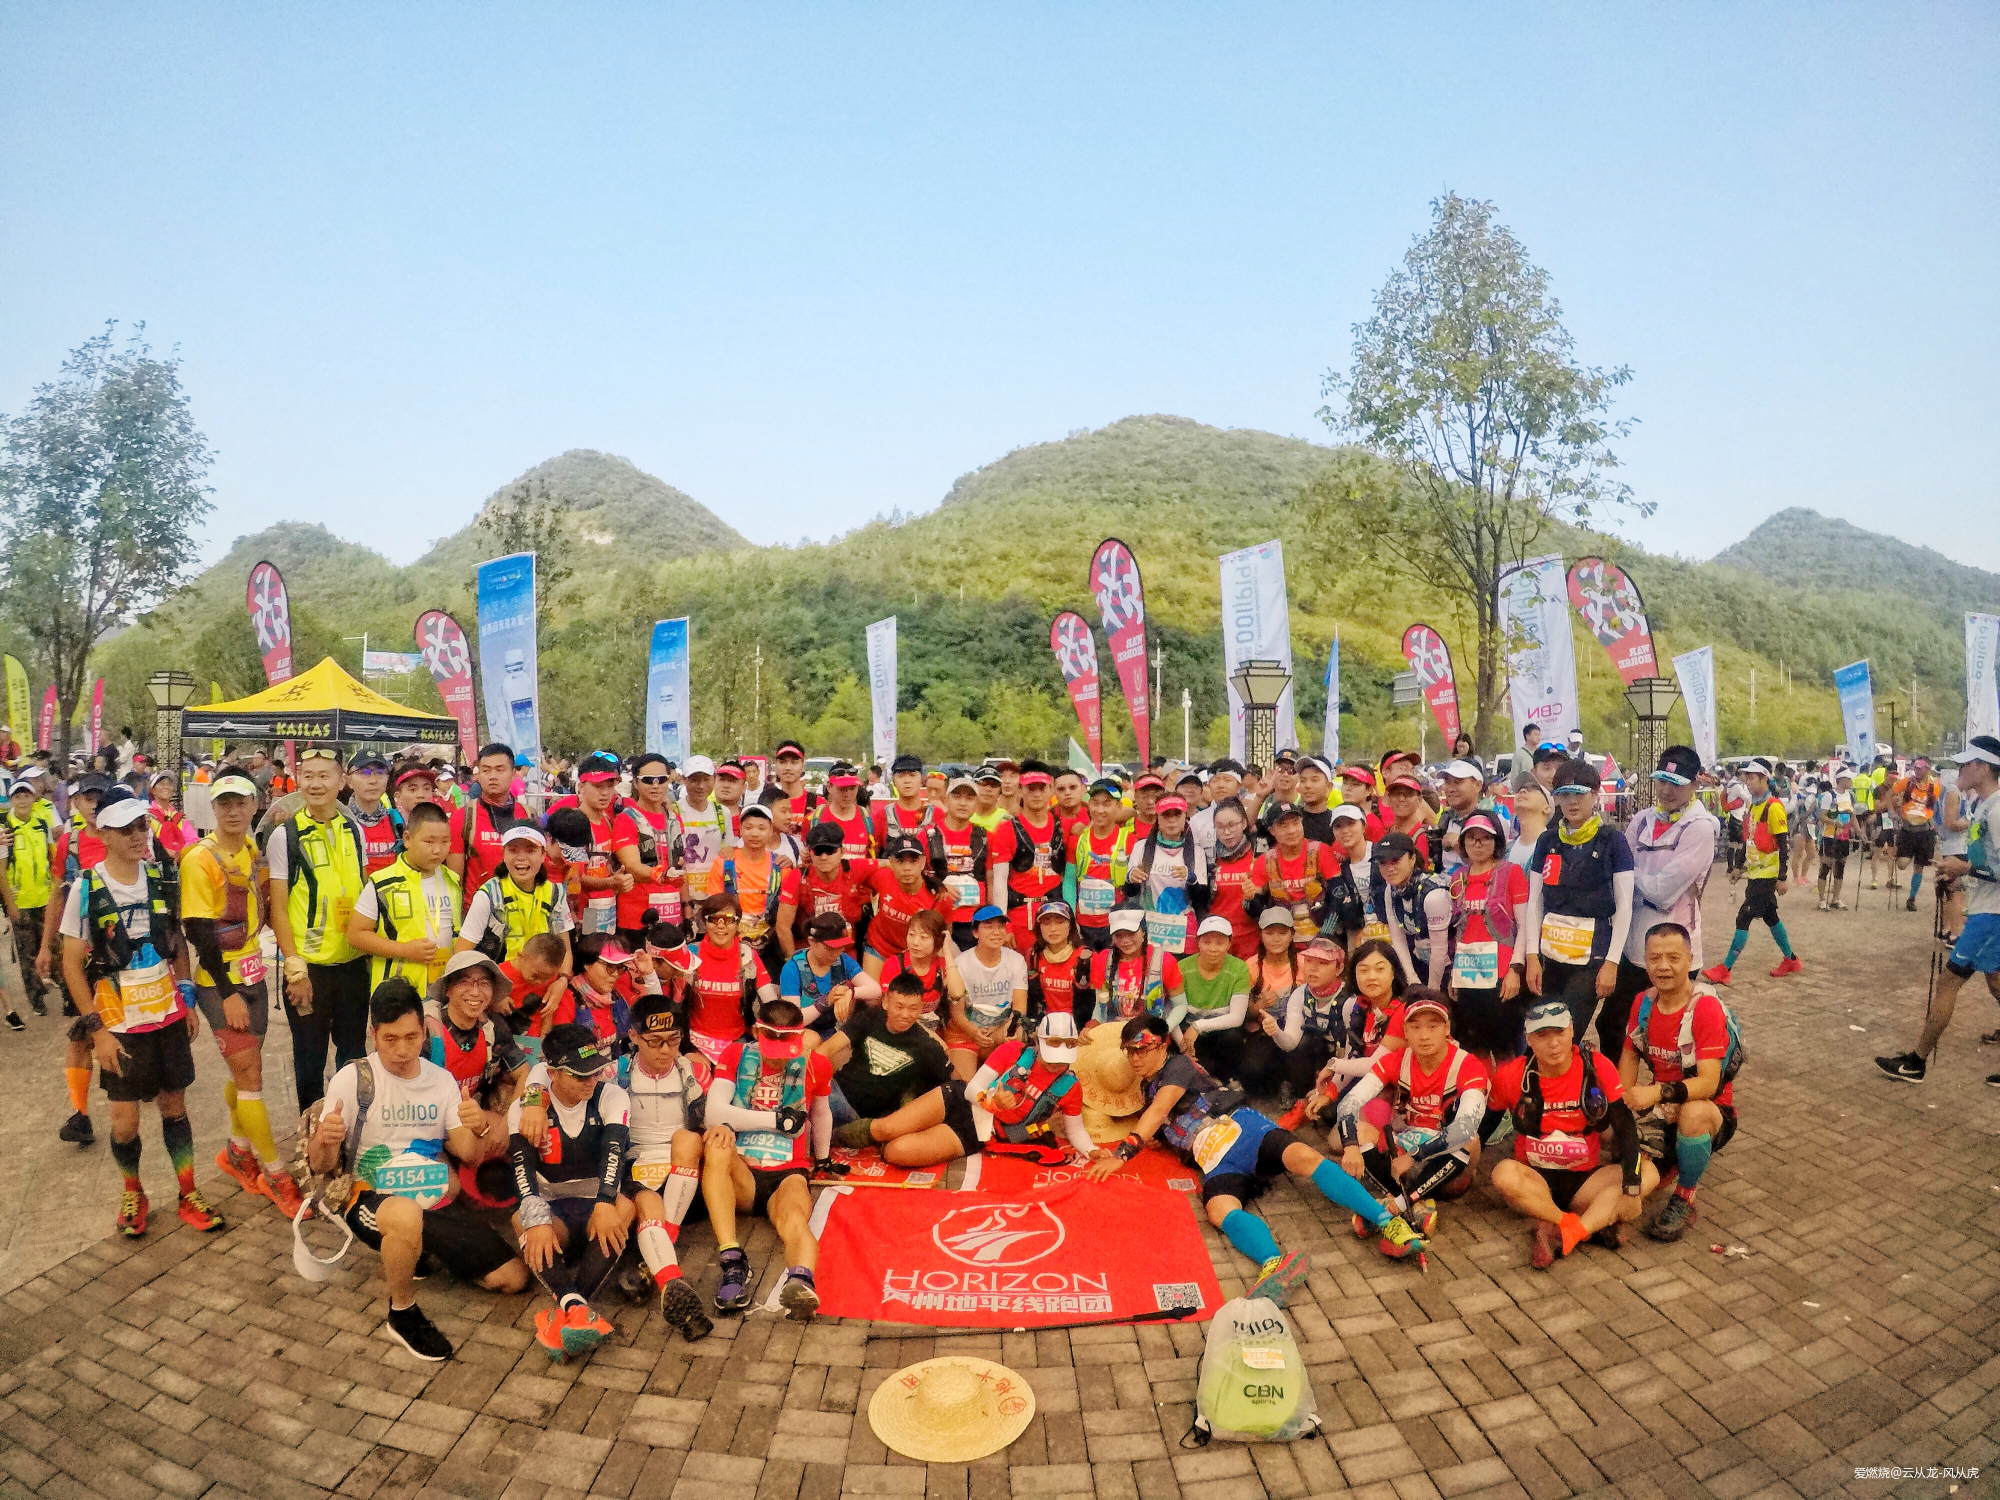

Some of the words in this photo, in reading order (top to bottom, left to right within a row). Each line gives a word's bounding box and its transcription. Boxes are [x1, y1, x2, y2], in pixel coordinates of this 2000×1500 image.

[276, 721, 331, 738] KAILAS
[420, 729, 456, 741] KAILAS
[1546, 927, 1575, 942] 4055
[130, 984, 164, 1002] 3066
[649, 1013, 673, 1029] Buff
[742, 1133, 775, 1148] 5092
[1530, 1141, 1564, 1156] 1009
[604, 1152, 619, 1186] JOYRUN
[385, 1168, 426, 1187] 5154
[883, 1268, 1108, 1293] HORIZON
[1243, 1384, 1285, 1399] CBN
